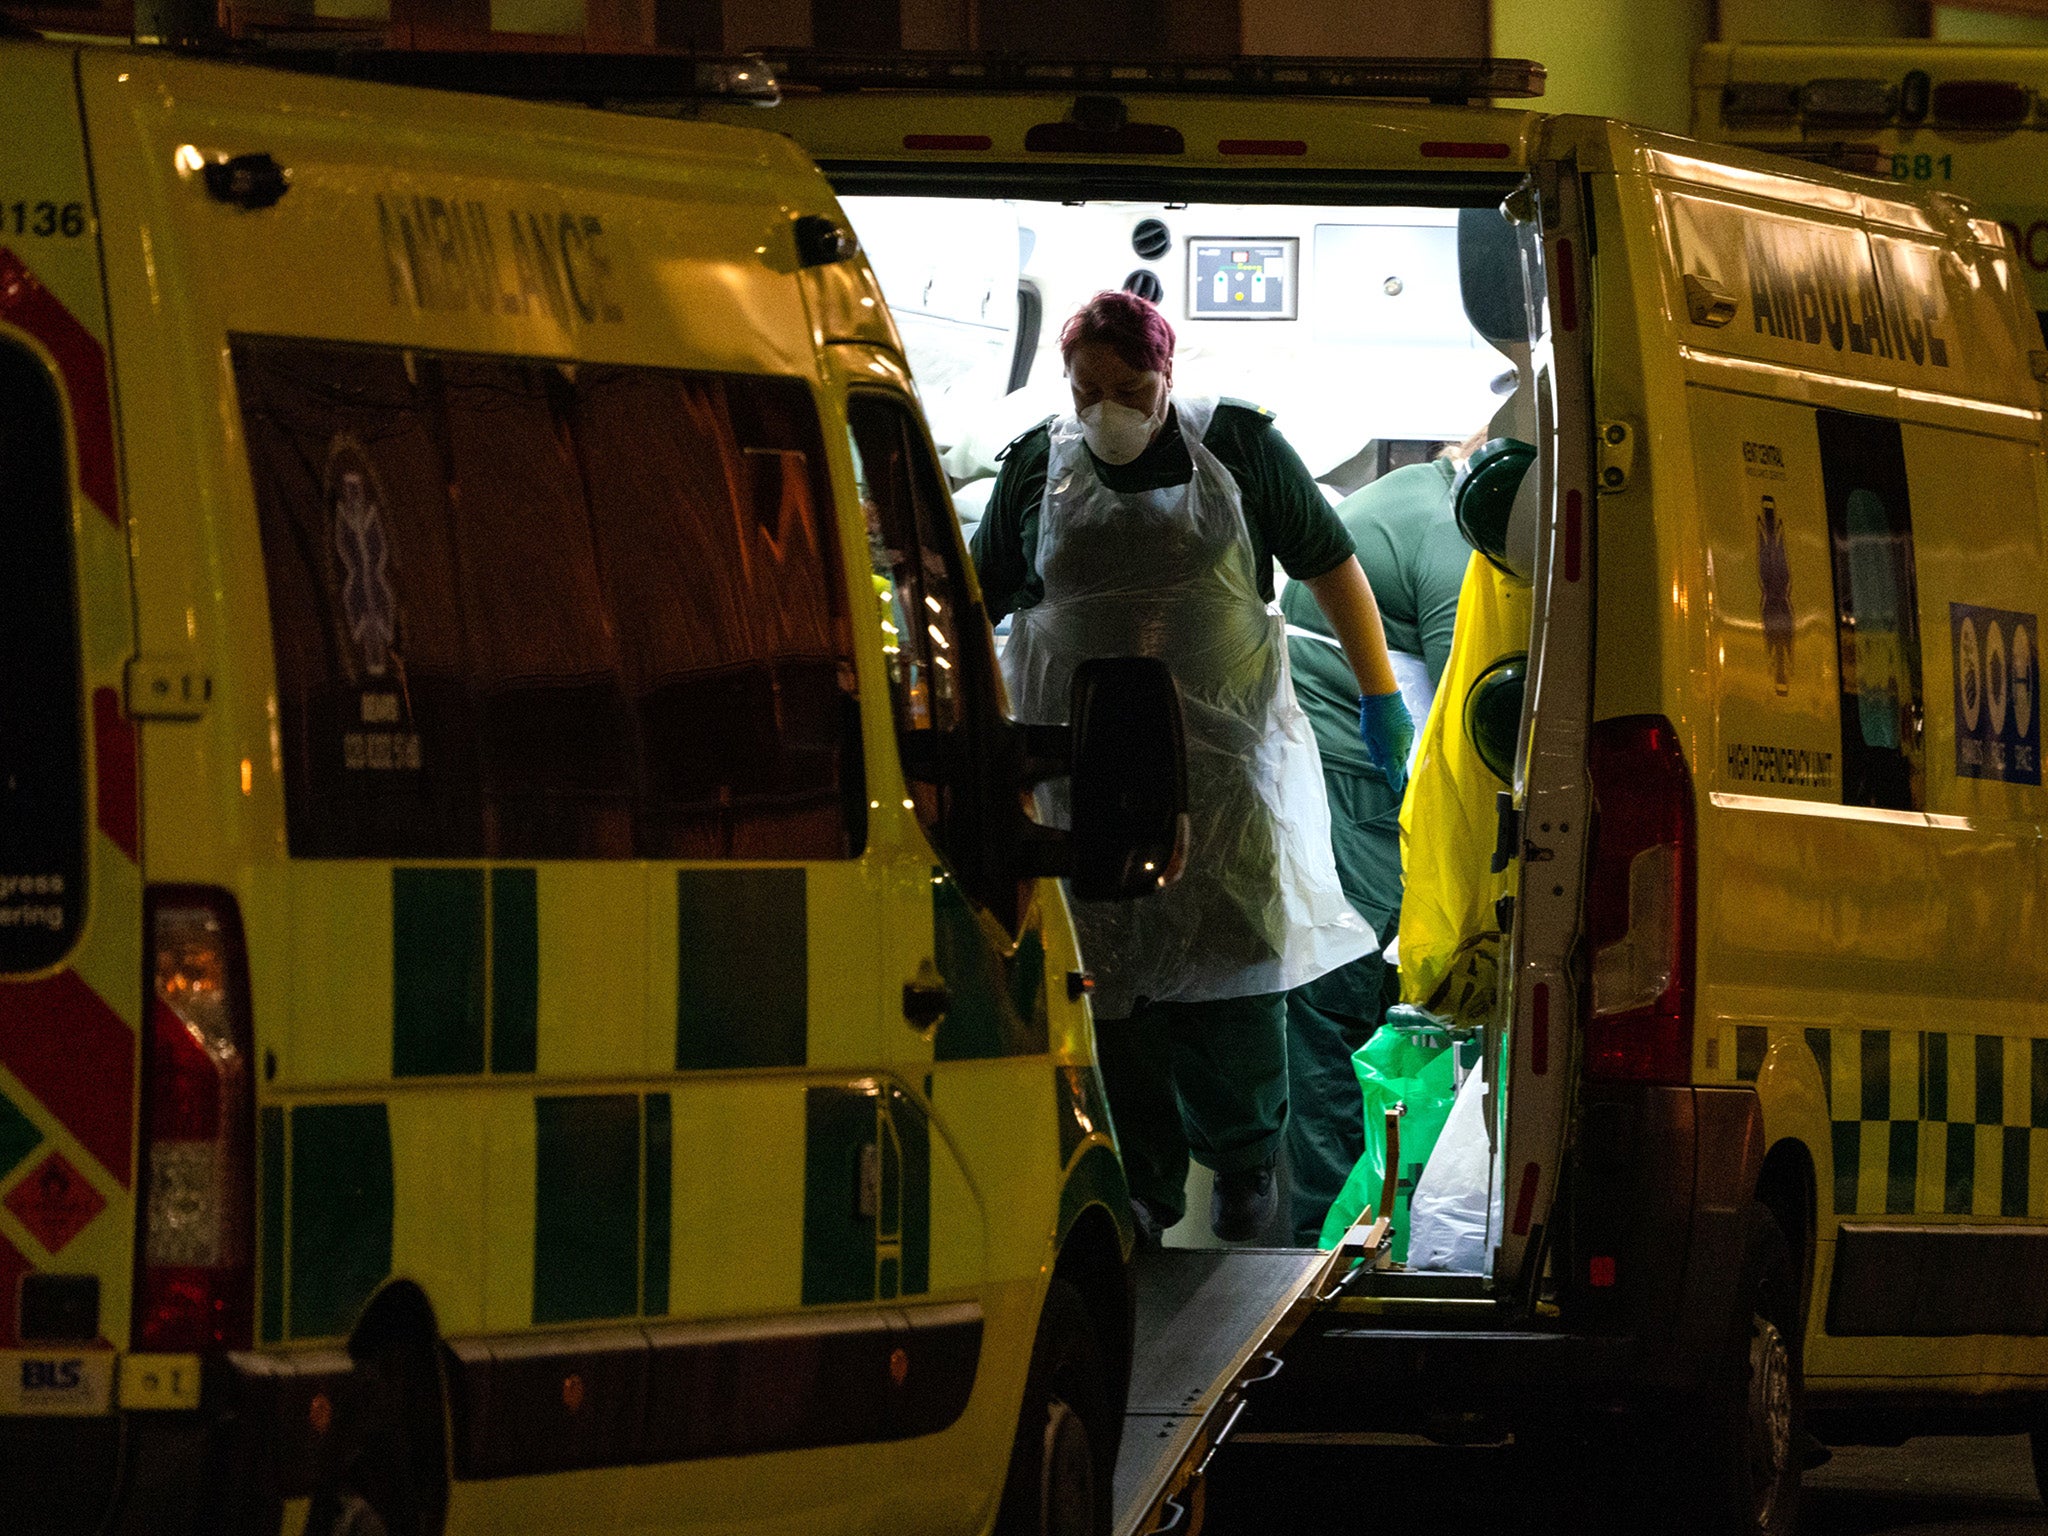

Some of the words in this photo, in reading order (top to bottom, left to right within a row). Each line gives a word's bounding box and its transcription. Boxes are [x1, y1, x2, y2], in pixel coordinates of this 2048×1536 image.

[0, 201, 84, 237] 136
[374, 193, 624, 324] AMBULANCE
[1743, 214, 1951, 368] AMBULANCE
[22, 1359, 83, 1390] BLS
